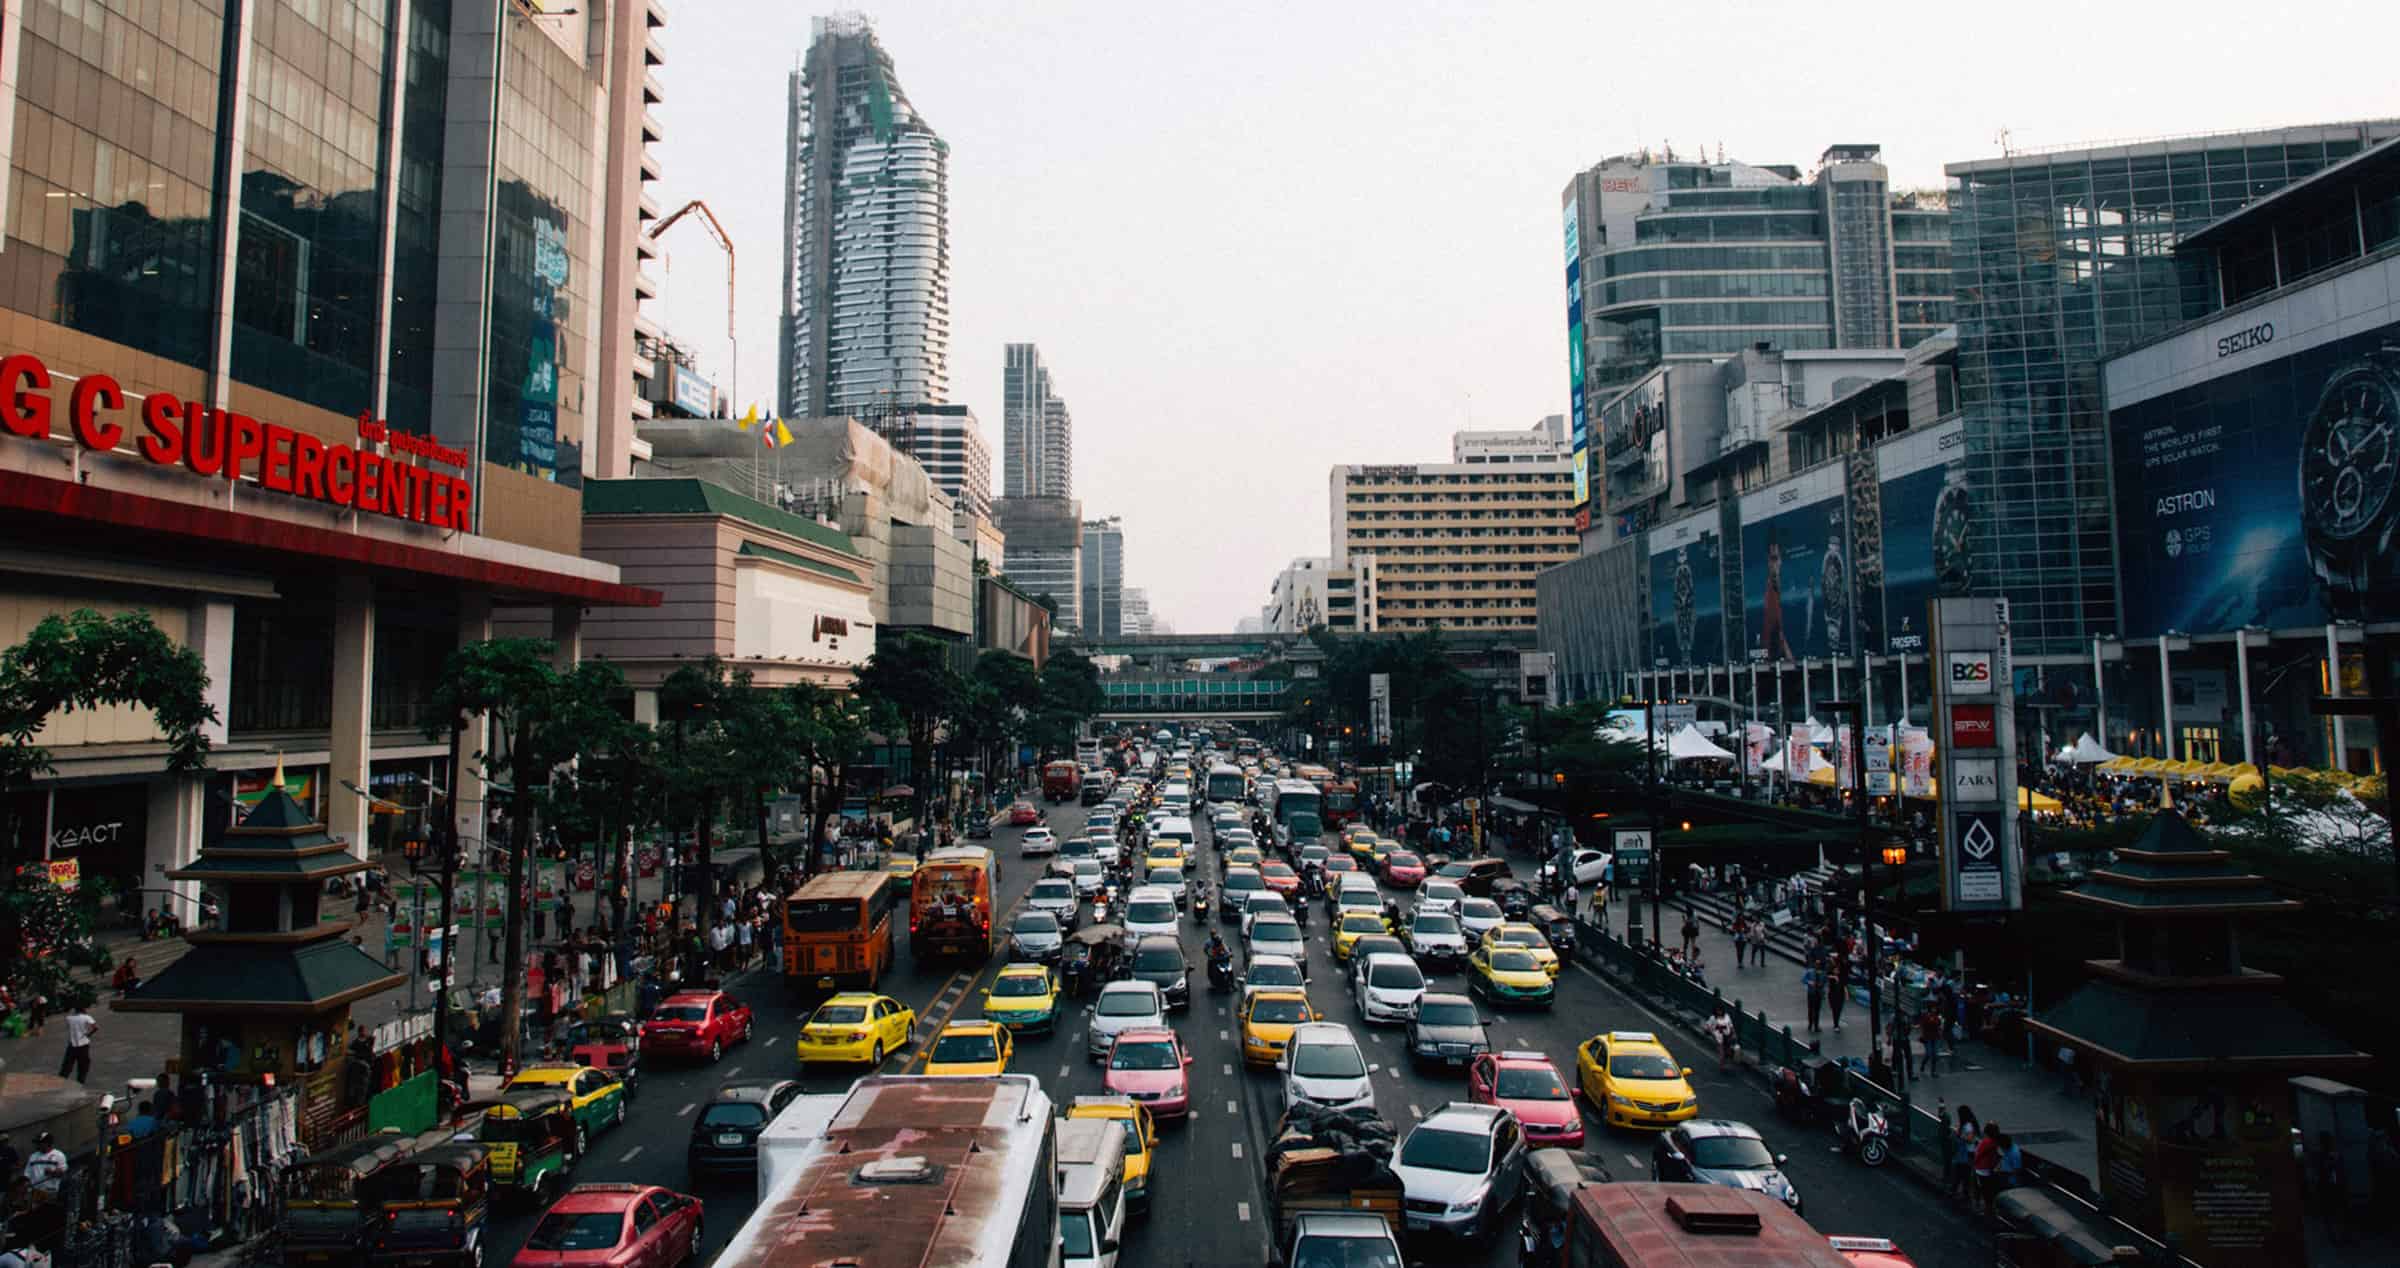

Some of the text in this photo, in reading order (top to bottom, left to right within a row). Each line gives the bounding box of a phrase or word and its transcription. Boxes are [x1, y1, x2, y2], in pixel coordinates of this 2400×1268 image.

[2217, 322, 2273, 357] SEIKO
[71, 373, 125, 450] C
[138, 393, 471, 532] SUPERCENTER
[2156, 488, 2216, 518] ASTRON
[2184, 525, 2211, 544] GPS
[1952, 662, 1988, 681] B2S
[1958, 774, 1994, 788] ZARA
